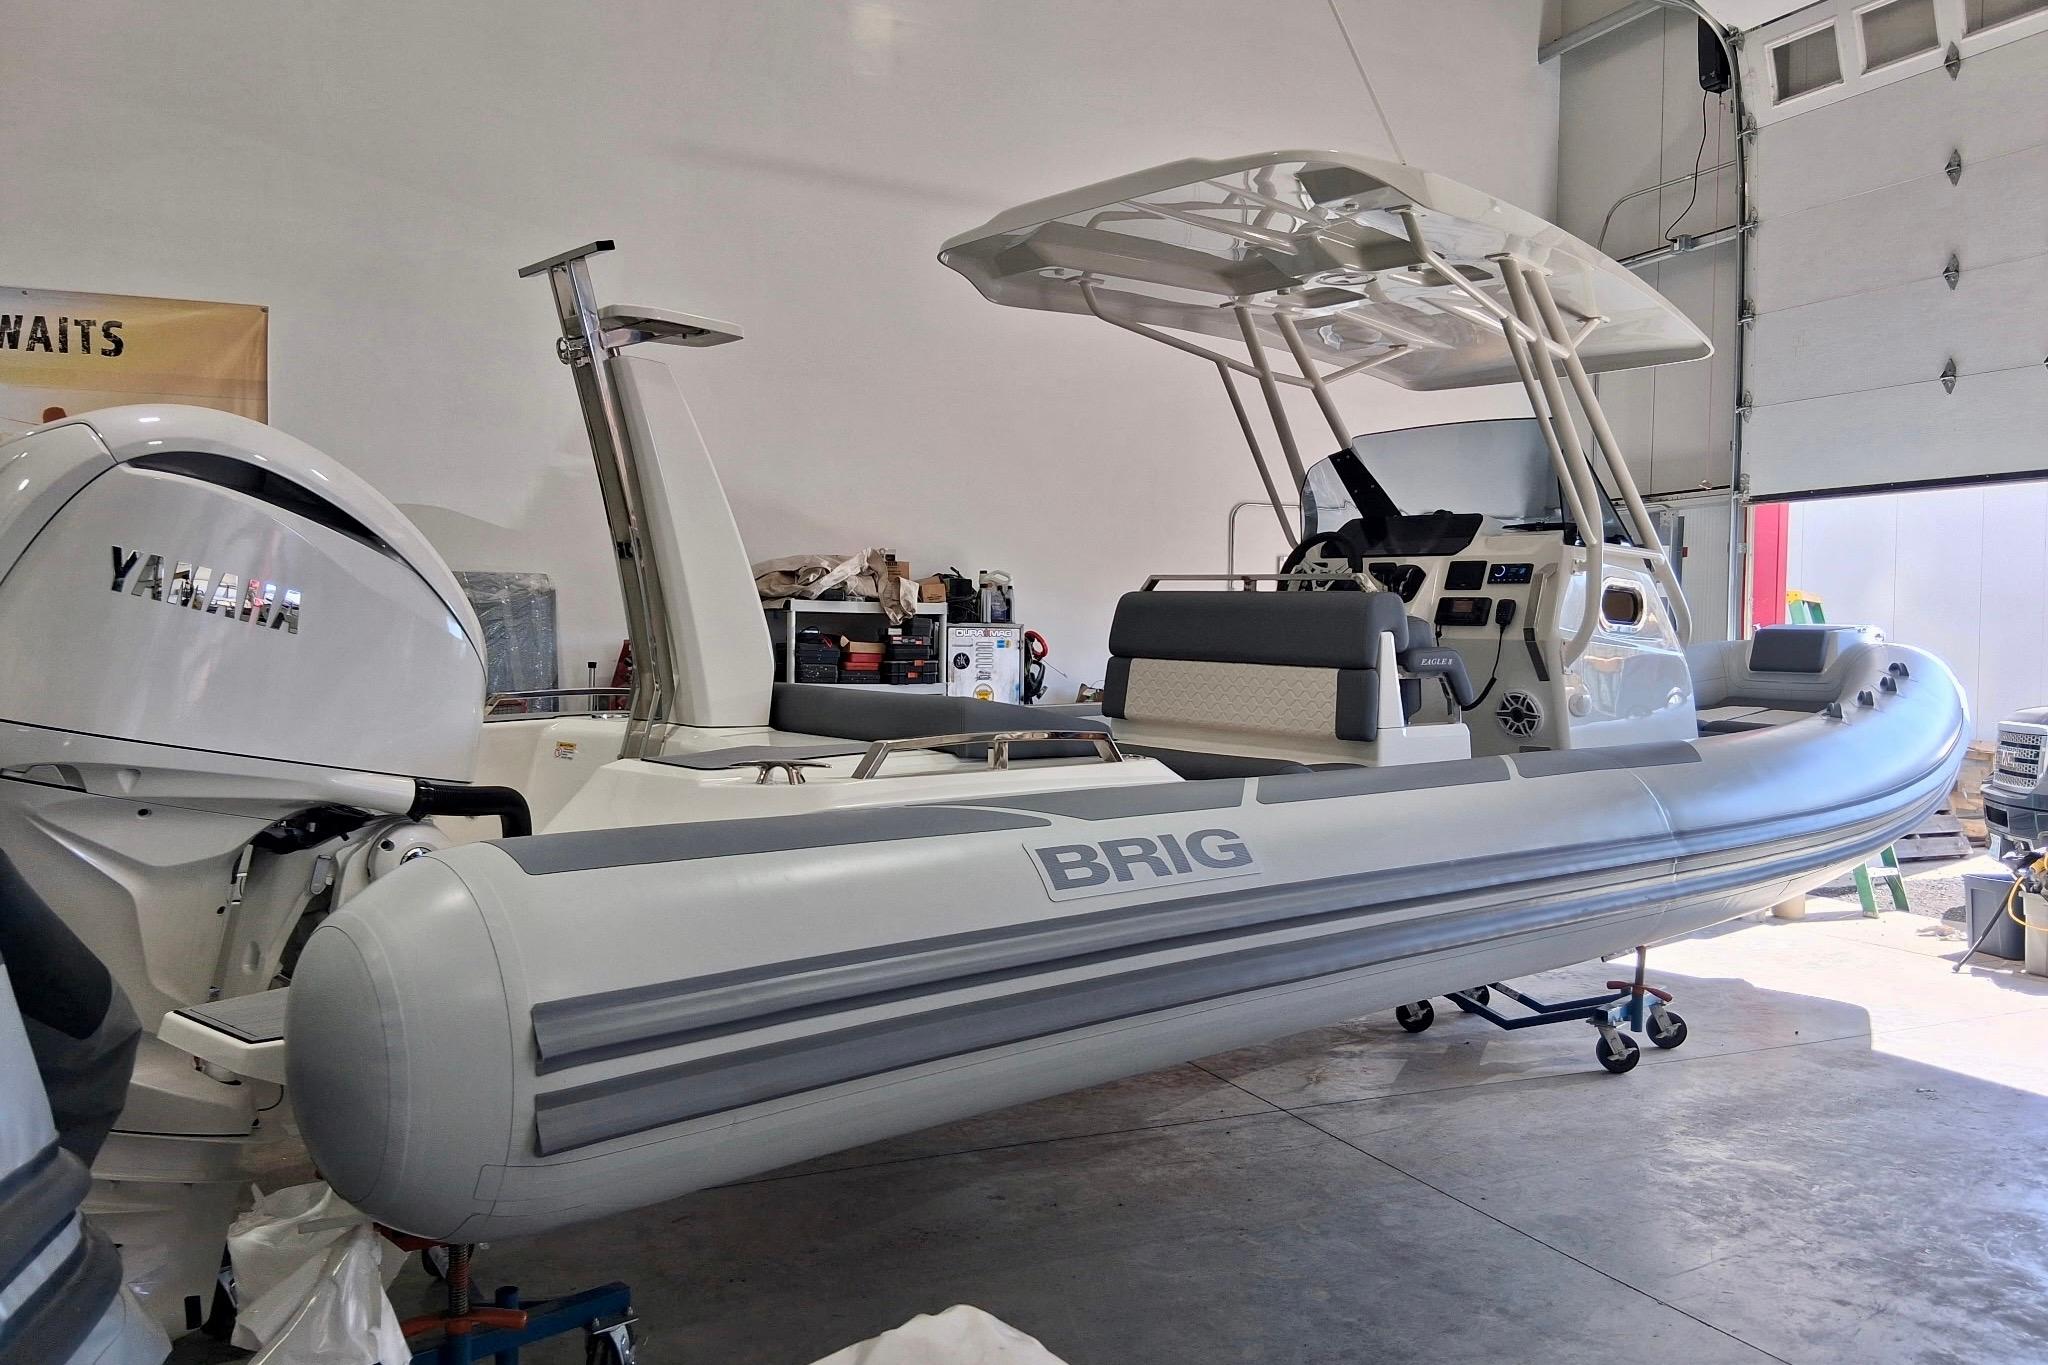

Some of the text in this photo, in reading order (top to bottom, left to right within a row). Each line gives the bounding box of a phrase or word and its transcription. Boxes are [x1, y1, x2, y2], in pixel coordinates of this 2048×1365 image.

[0, 314, 124, 357] WAITS
[111, 544, 301, 634] YAMAHA
[1420, 658, 1447, 666] EAGLE
[1035, 828, 1253, 891] BRIG
